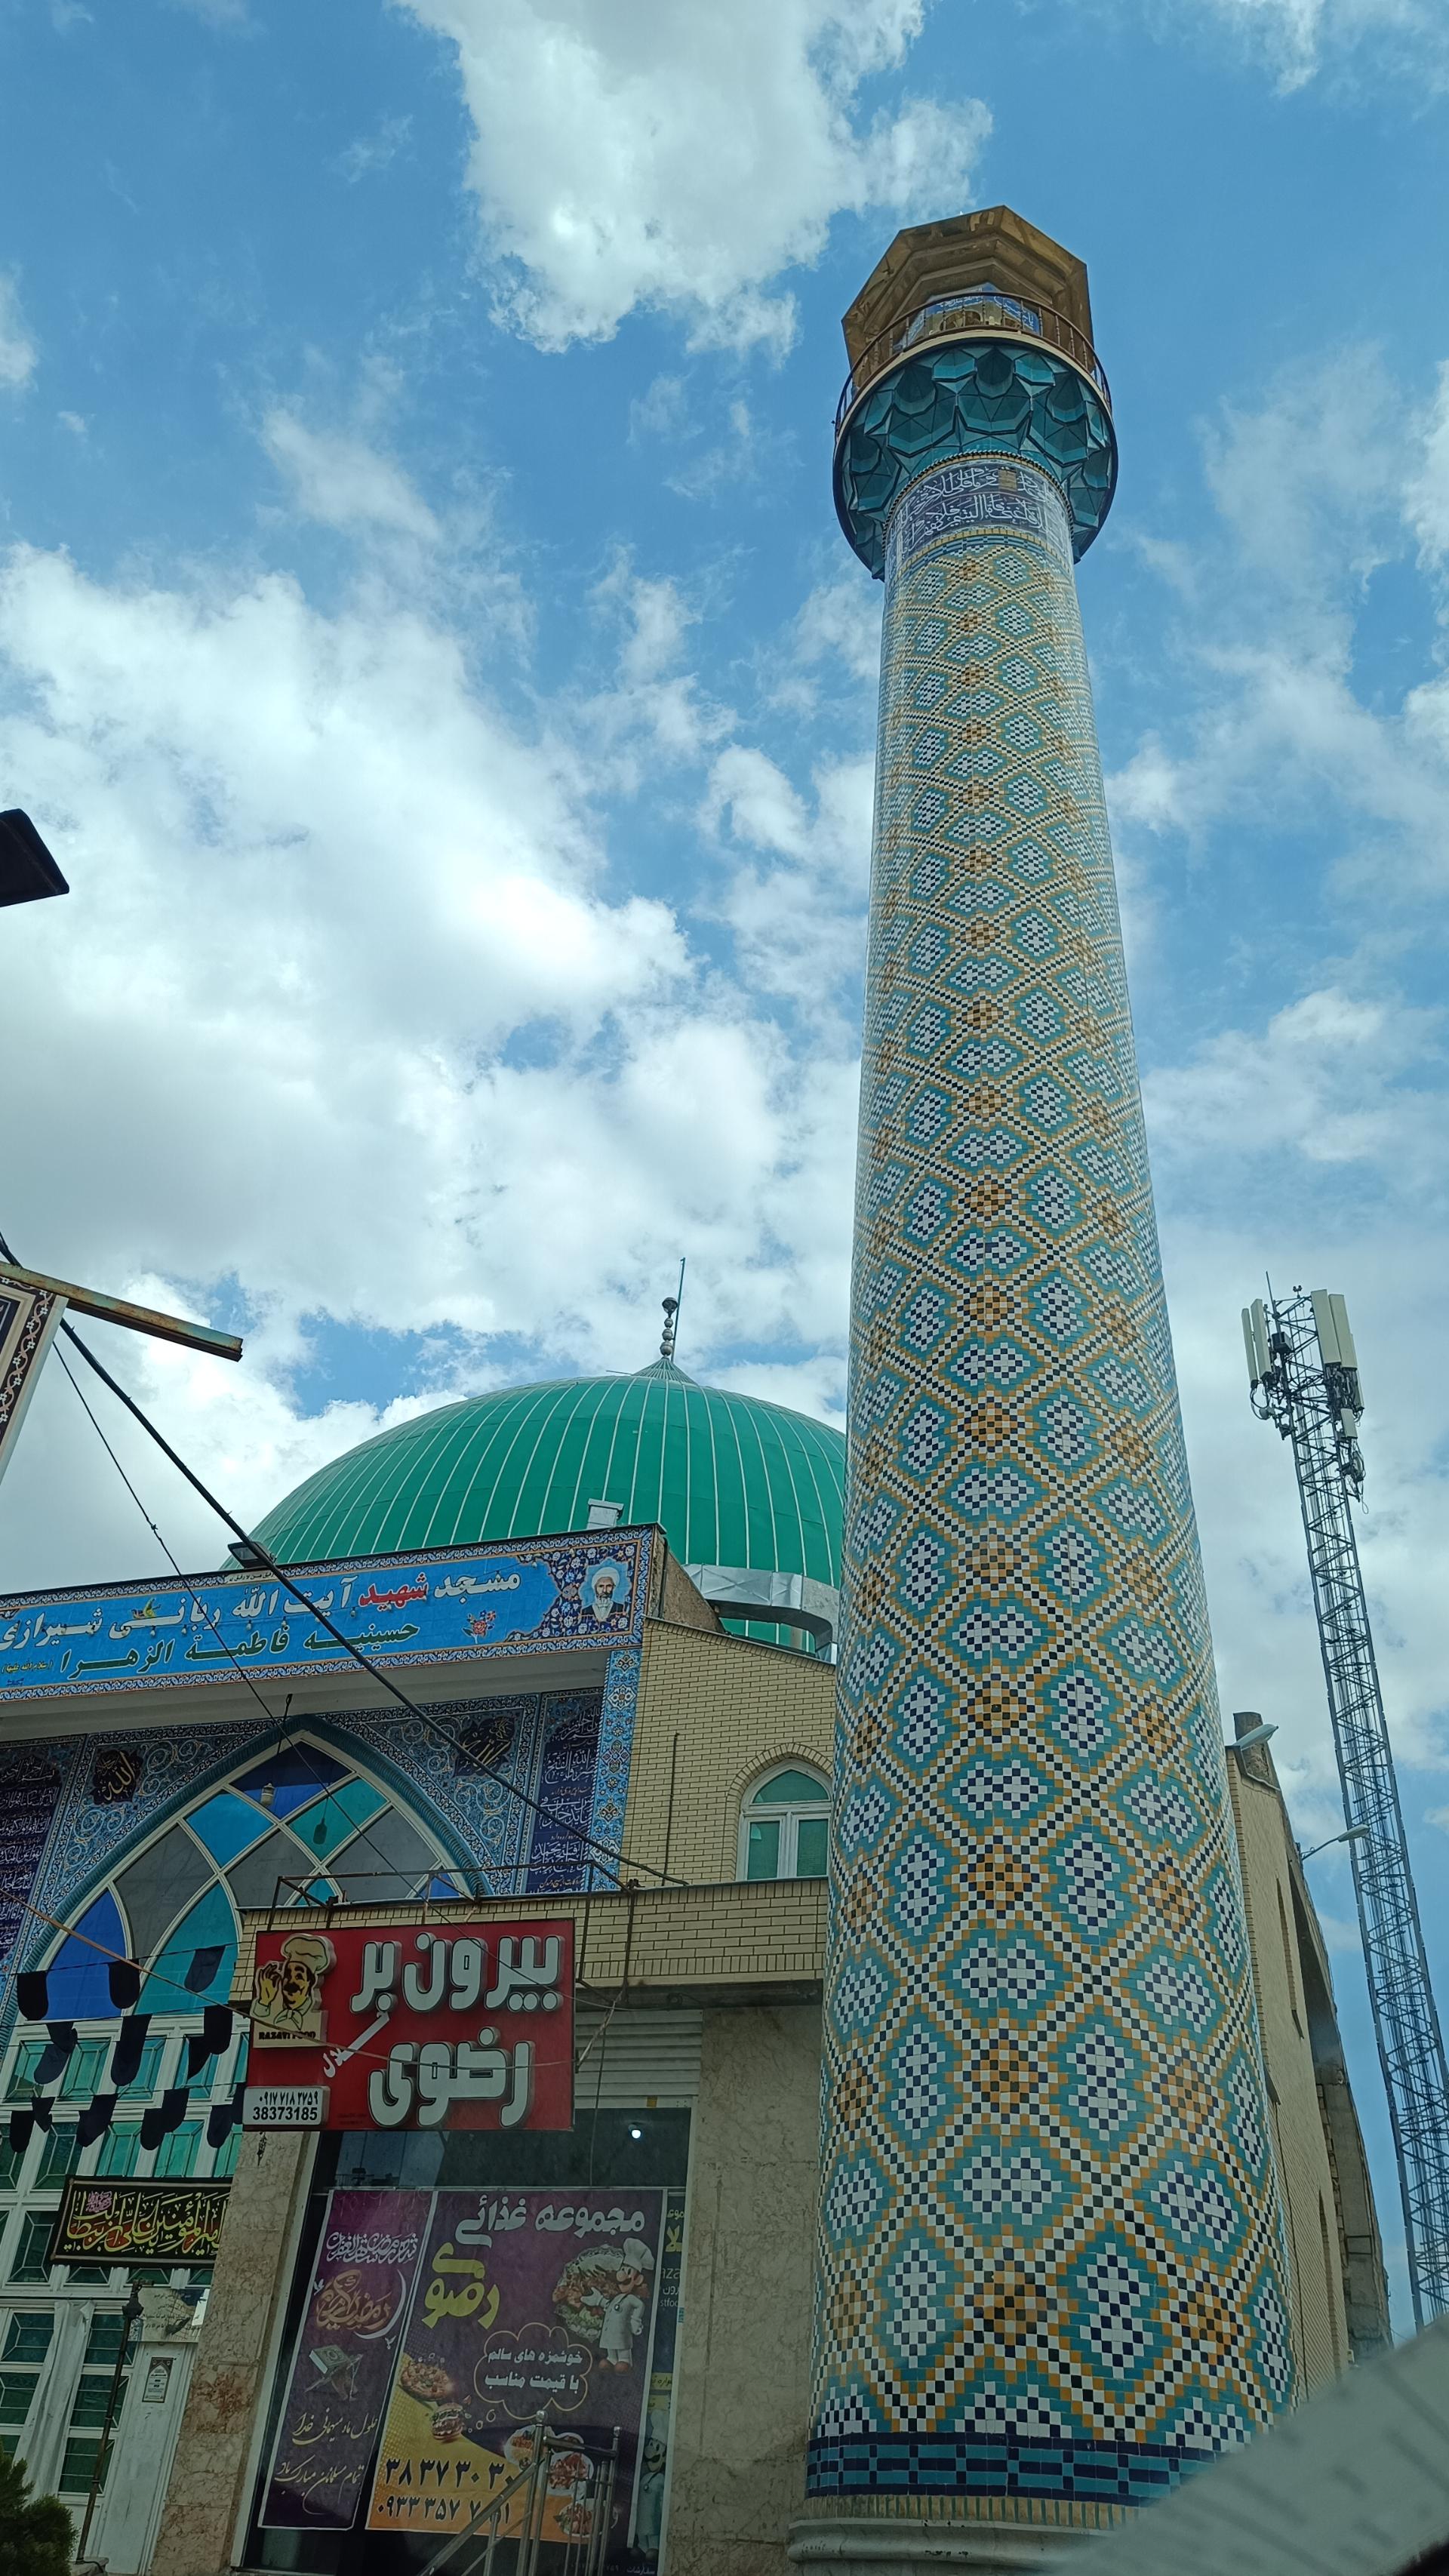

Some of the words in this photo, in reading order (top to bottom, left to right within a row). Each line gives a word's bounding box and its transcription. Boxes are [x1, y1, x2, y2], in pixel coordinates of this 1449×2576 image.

[232, 1586, 278, 1619] الله
[283, 1575, 358, 1617] آیت
[358, 1571, 428, 1611] شهید
[434, 1571, 521, 1604] مسجد
[0, 1608, 103, 1651] شیرازی
[109, 1596, 221, 1639] ربانی
[303, 1623, 420, 1651] حسینیه
[60, 1639, 175, 1680] الزهرا
[349, 1940, 400, 2013] بر
[402, 1932, 564, 2011] بیرون
[259, 2031, 291, 2040] RAZAVI
[368, 2026, 534, 2127] رضوی
[253, 2107, 318, 2121] 38373185
[535, 2204, 645, 2239] مجموعه
[421, 2242, 500, 2330] رضوی
[488, 2347, 512, 2363] سالم
[514, 2349, 535, 2363] های
[538, 2350, 583, 2366] خوشمزه
[485, 2371, 525, 2390] مناسب
[530, 2374, 566, 2393] قیمت
[569, 2374, 580, 2394] با
